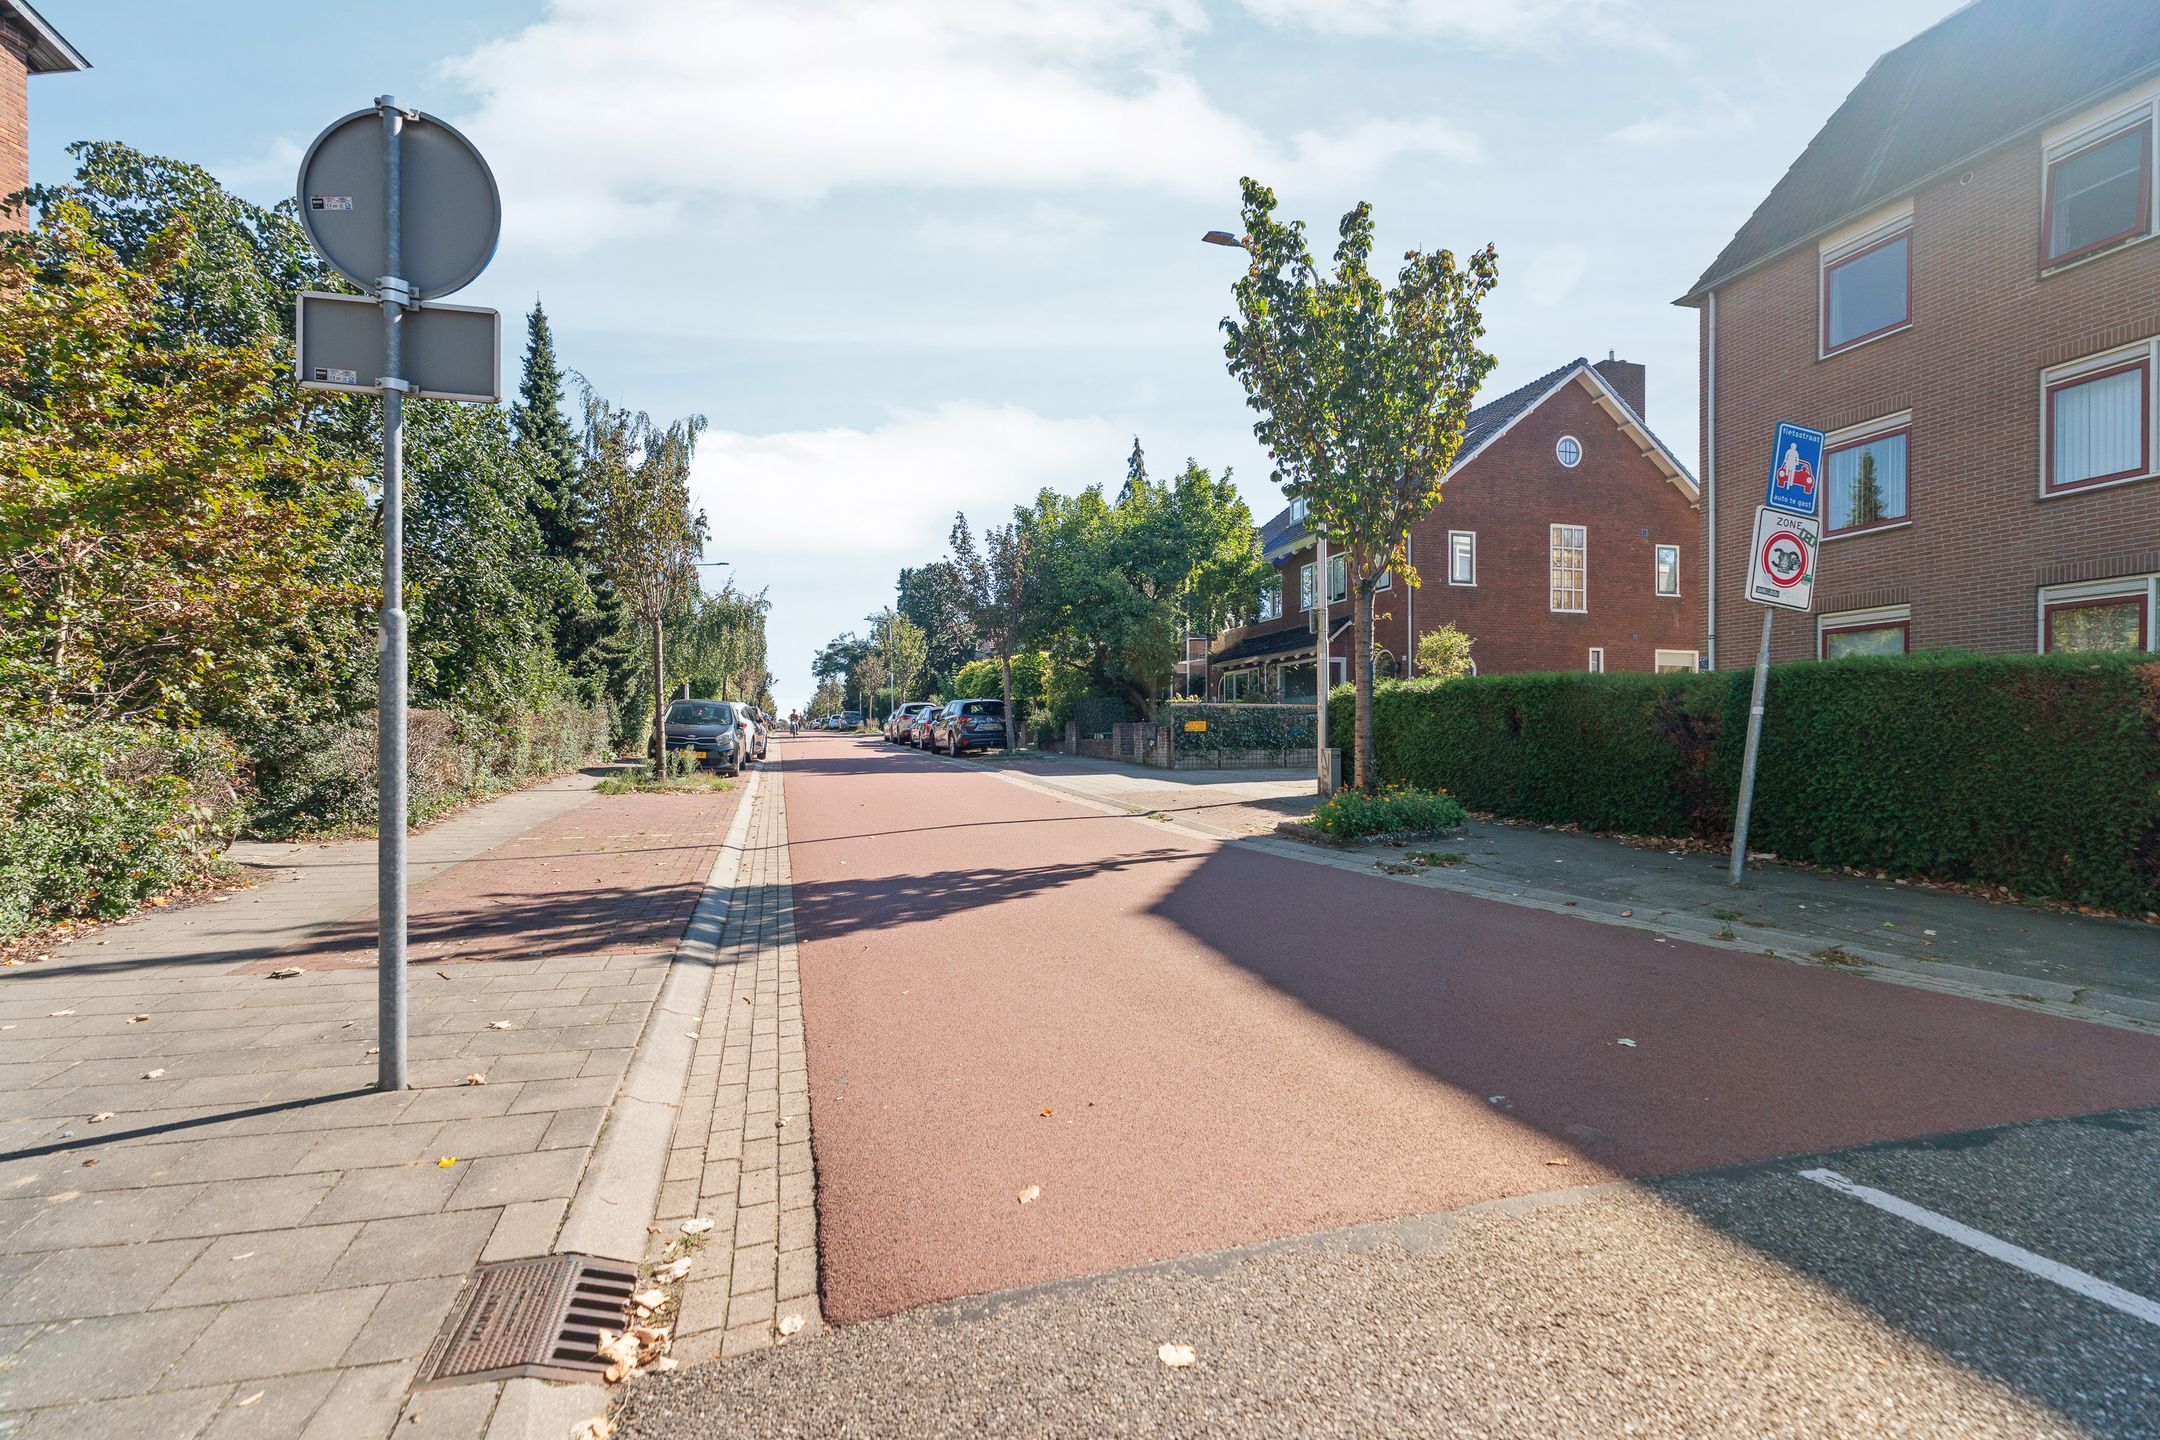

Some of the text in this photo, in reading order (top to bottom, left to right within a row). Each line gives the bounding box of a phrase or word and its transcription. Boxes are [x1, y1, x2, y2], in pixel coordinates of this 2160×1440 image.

[1783, 428, 1821, 442] fietsstraat
[1773, 494, 1812, 509] auto te gast
[1777, 517, 1803, 529] ZONE
